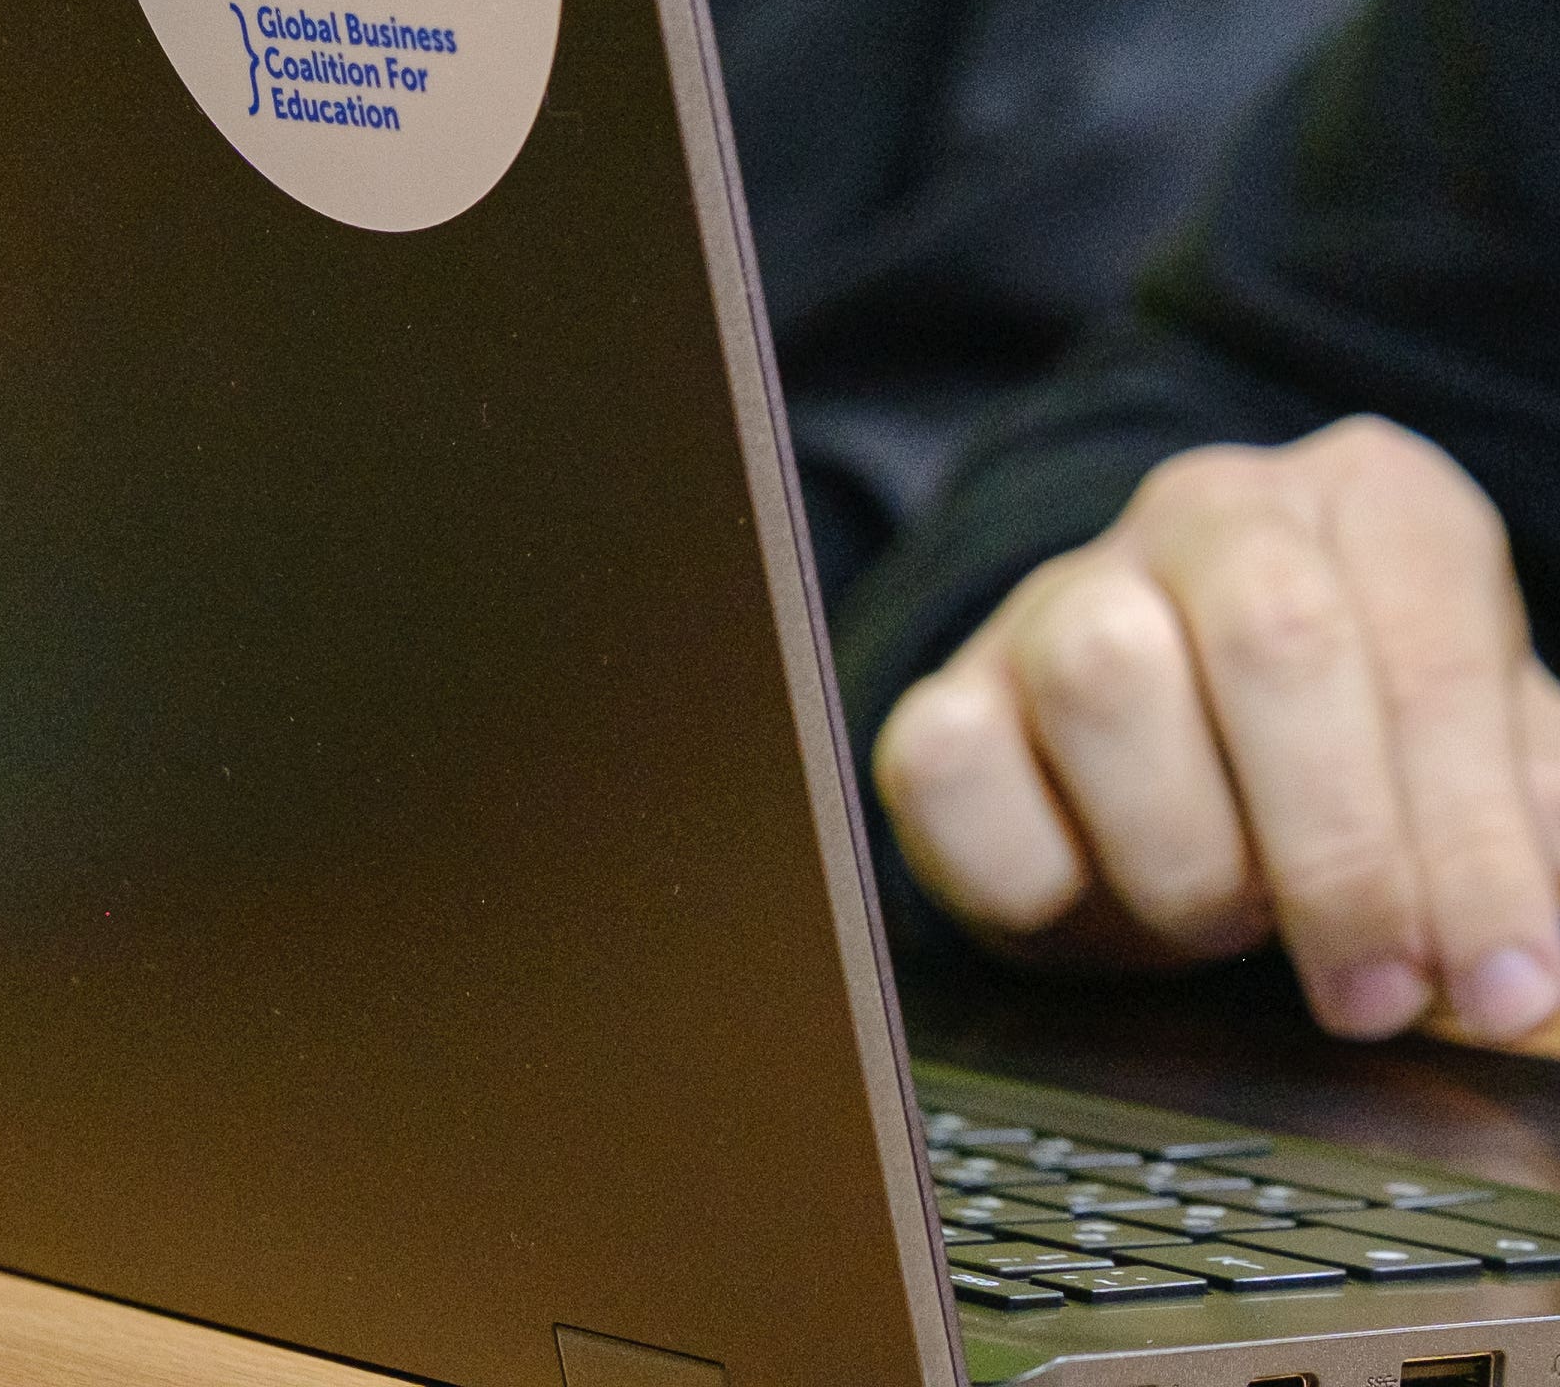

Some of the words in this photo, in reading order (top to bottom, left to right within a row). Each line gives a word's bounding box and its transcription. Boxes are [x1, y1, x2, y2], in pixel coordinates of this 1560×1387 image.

[258, 6, 342, 46] Global
[347, 11, 457, 55] Business
[264, 48, 380, 87] Coalition
[387, 54, 428, 93] For
[272, 90, 400, 131] Education
